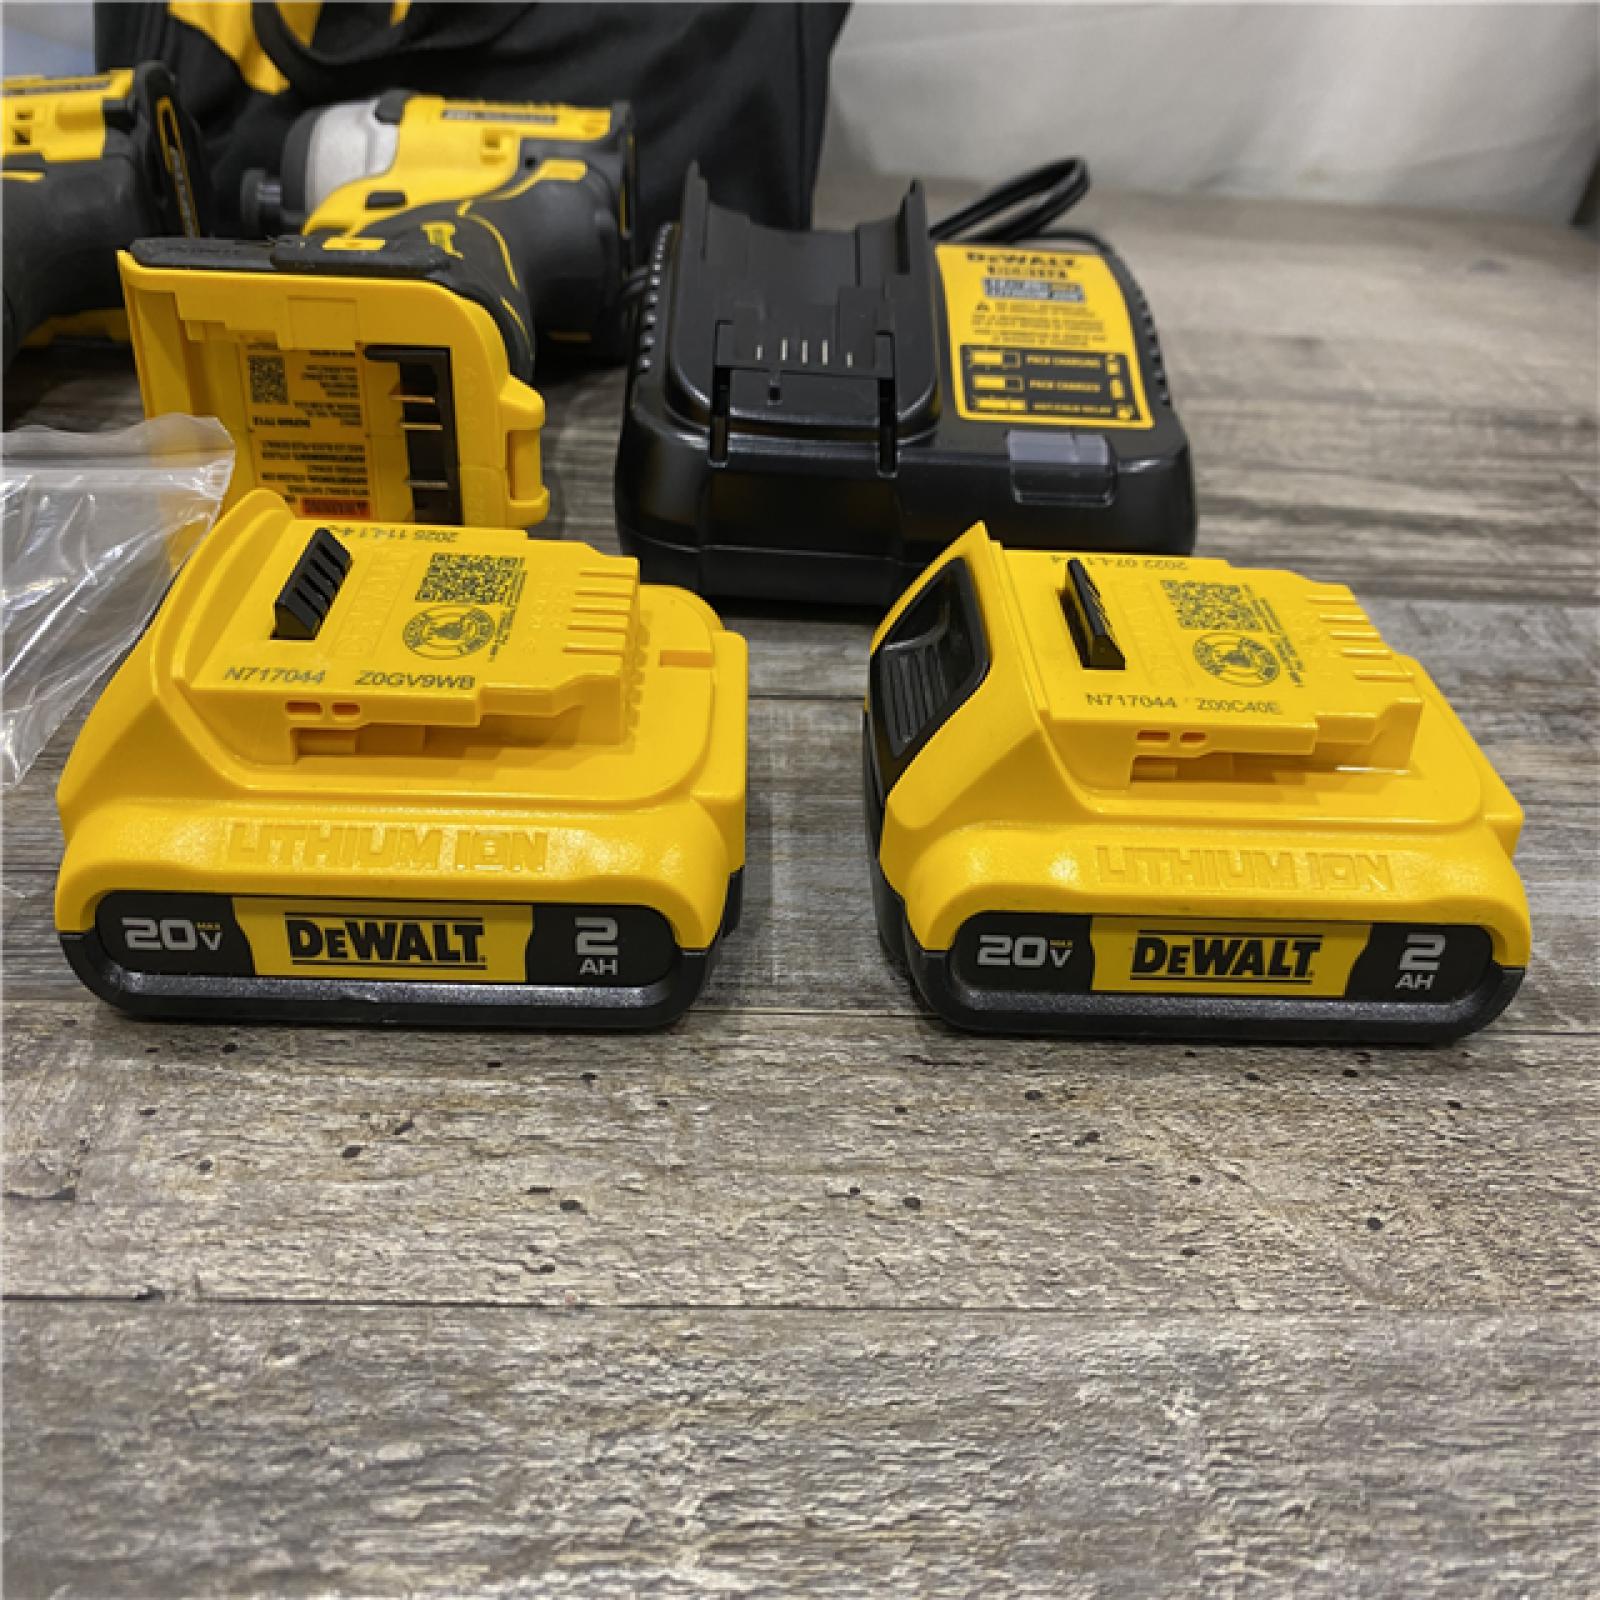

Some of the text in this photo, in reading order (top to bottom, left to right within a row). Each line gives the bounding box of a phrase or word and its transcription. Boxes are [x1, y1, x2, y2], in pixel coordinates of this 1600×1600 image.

[222, 666, 326, 685] N717044
[1085, 692, 1179, 709] N717044
[226, 822, 549, 873] LITHIUM ION
[1096, 846, 1395, 891] LITHIUM ION
[121, 916, 222, 951] 20V
[574, 916, 619, 956] 2
[579, 959, 619, 976] AH
[977, 934, 1073, 968] 20V
[1398, 934, 1446, 971] 2
[1393, 974, 1436, 991] AH
